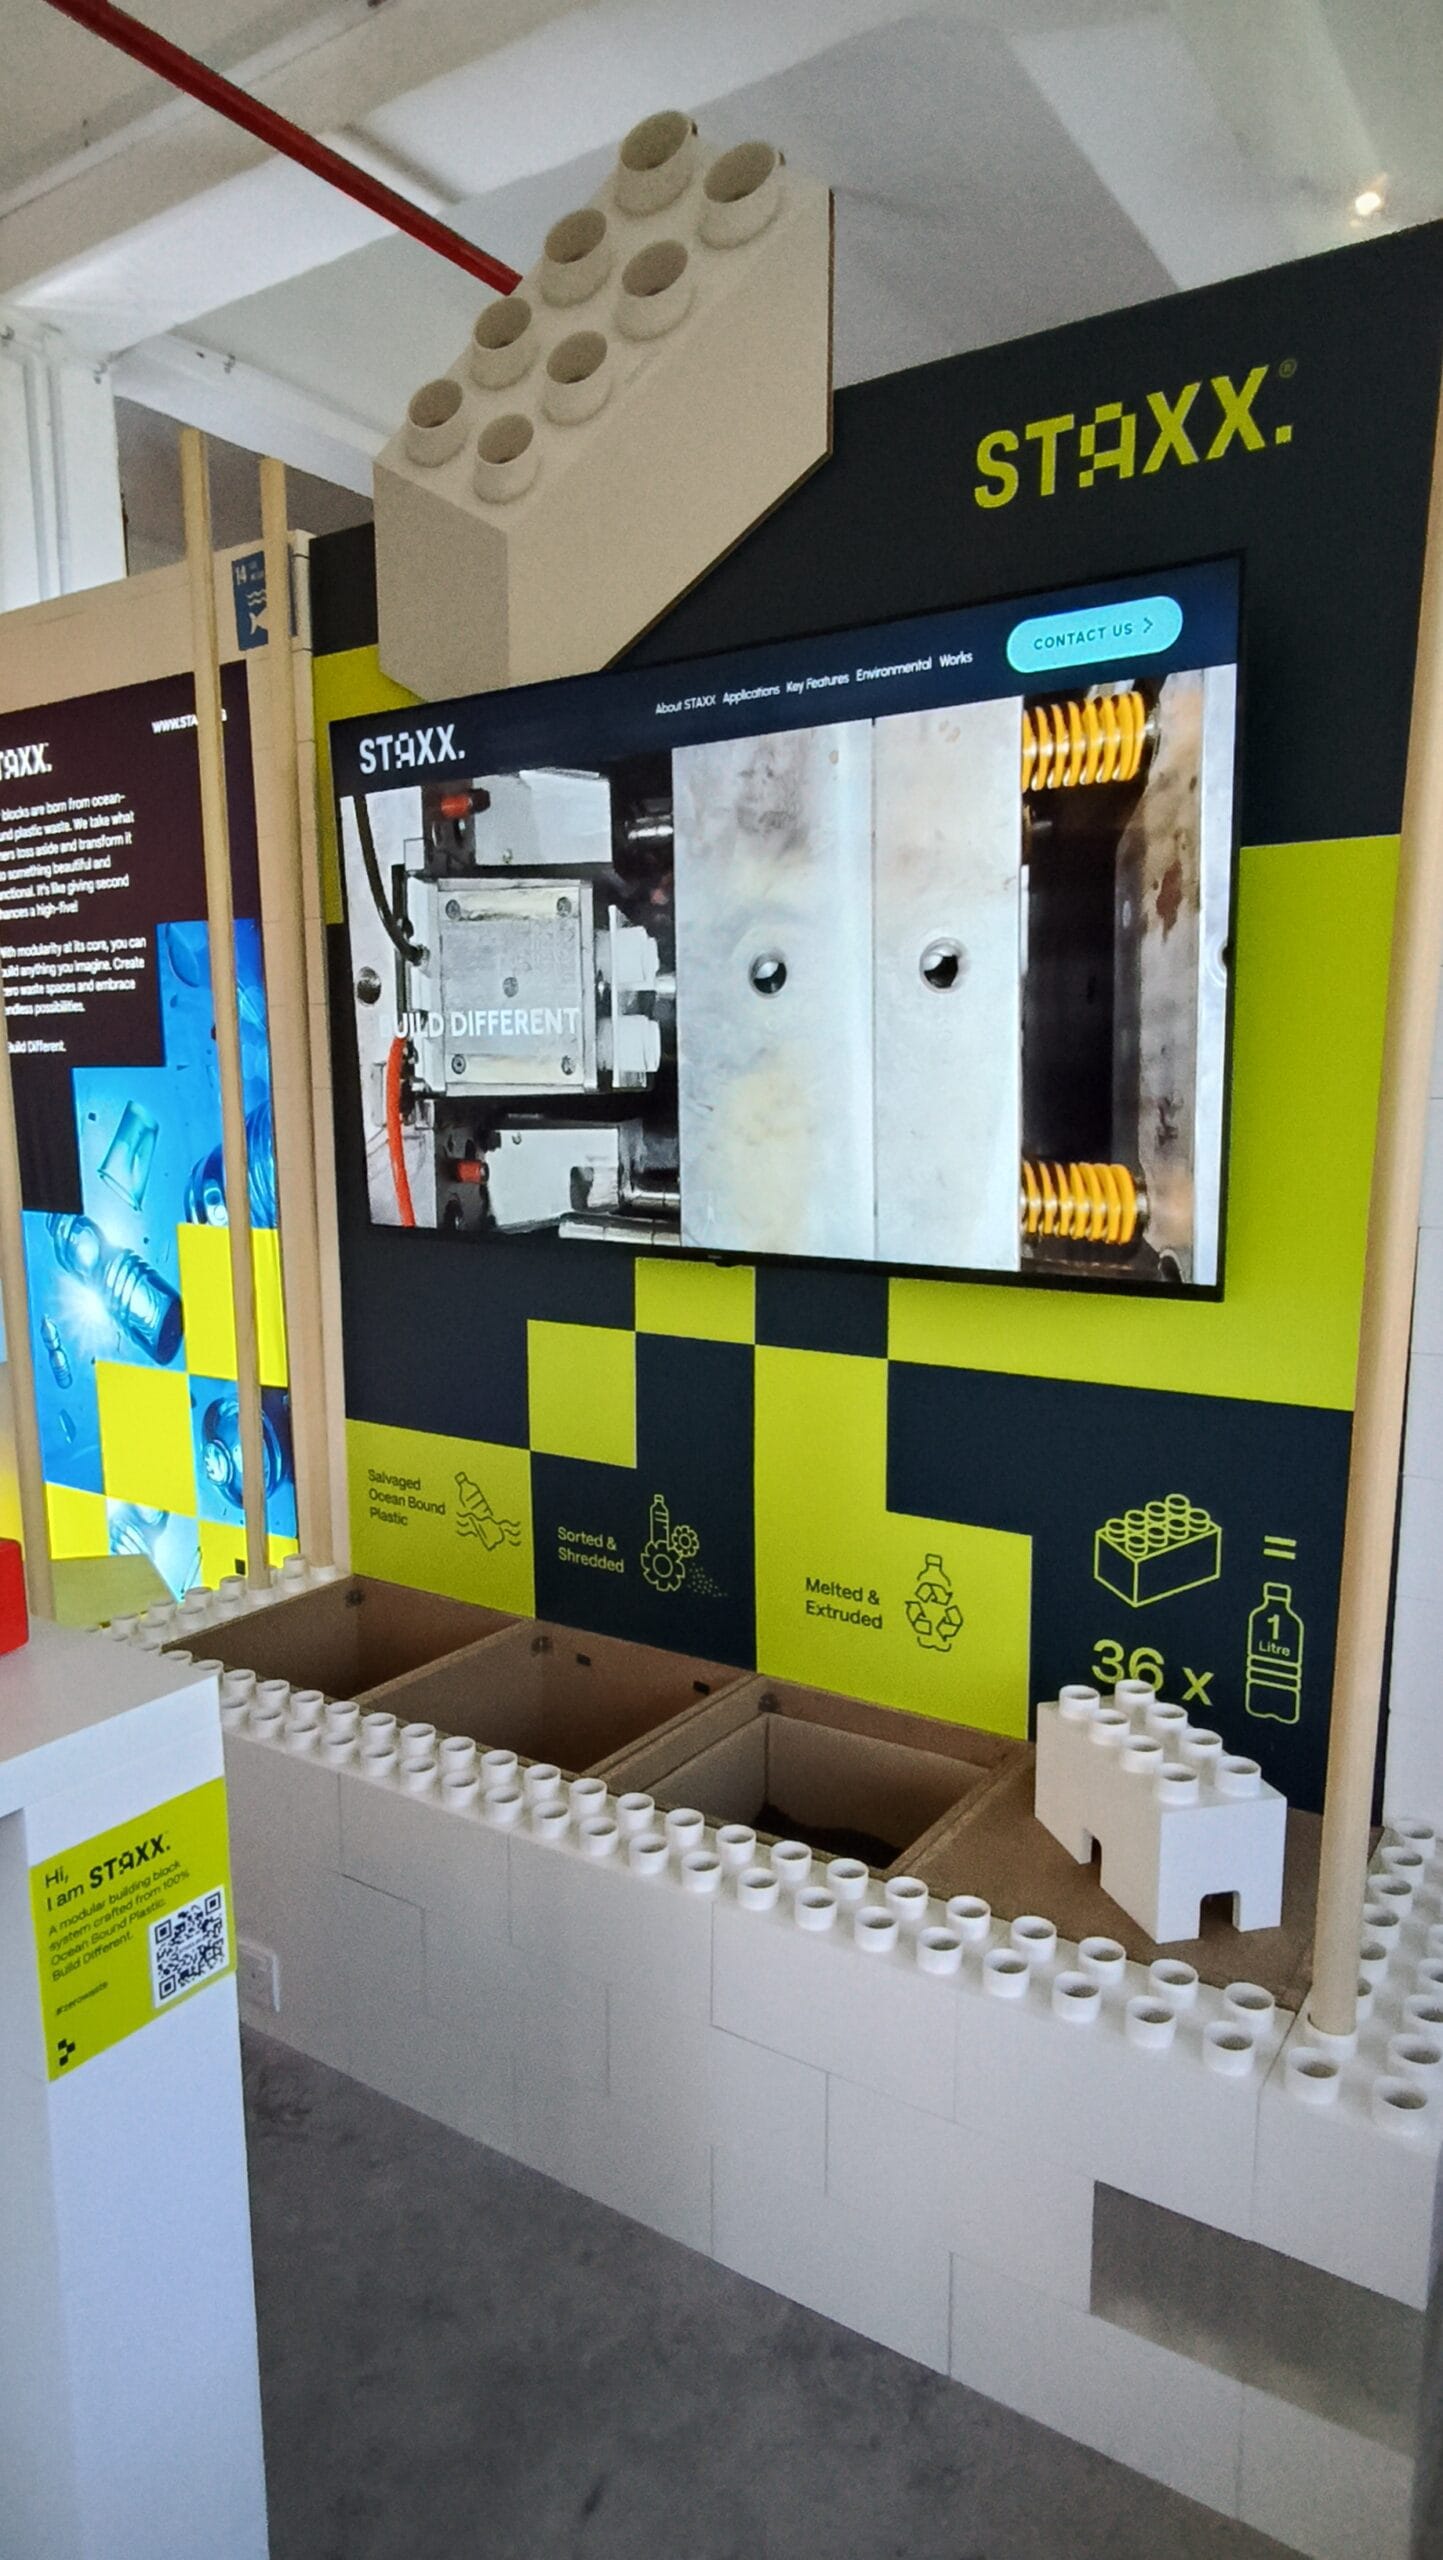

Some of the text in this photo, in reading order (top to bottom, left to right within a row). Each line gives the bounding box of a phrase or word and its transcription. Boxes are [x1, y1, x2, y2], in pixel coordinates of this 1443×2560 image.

[236, 564, 247, 586] 14
[1034, 623, 1133, 650] CONTACT US
[655, 651, 973, 714] About STAXX Applications Key Features Environmental Works
[359, 724, 466, 774] STAXX.
[1, 805, 30, 821] blocks
[30, 805, 45, 817] are
[68, 797, 90, 811] from
[14, 824, 43, 842] plastic
[72, 817, 88, 831] We
[89, 814, 110, 829] take
[111, 810, 135, 825] what
[35, 842, 59, 857] aside
[60, 838, 77, 852] and
[78, 833, 124, 850] transform
[124, 831, 133, 845] it
[7, 864, 52, 878] something
[52, 857, 92, 875] beautiful
[93, 854, 111, 869] and
[67, 878, 95, 896] giving
[95, 873, 130, 890] second
[17, 942, 62, 957] modularity
[63, 941, 72, 954] at
[110, 939, 128, 953] you
[129, 937, 147, 949] can
[20, 962, 56, 978] anything
[57, 963, 74, 977] you
[112, 956, 145, 970] Create
[20, 983, 45, 996] waste
[45, 982, 76, 997] spaces
[77, 978, 94, 992] and
[95, 977, 136, 992] embrace
[451, 1007, 580, 1037] DIFFERENT
[368, 1469, 421, 1491] Salvaged
[368, 1488, 446, 1515] Ocean Bound
[370, 1507, 408, 1526] Plastic
[557, 1526, 617, 1550] Sorted &
[558, 1547, 624, 1573] Shredded
[806, 1577, 880, 1605] Melted &
[806, 1600, 883, 1629] Extruded
[1267, 1614, 1280, 1640] 1
[1258, 1640, 1291, 1656] Litre
[1091, 1639, 1165, 1691] 36
[45, 1866, 69, 1889] Hi,
[47, 1834, 171, 1912] I am STAXX.
[49, 1860, 181, 1936] A modular building block
[49, 1924, 91, 1951] system
[93, 1901, 133, 1928] crafted
[135, 1885, 161, 1906] from
[51, 1940, 89, 1966] Ocean
[91, 1918, 127, 1944] Bound
[52, 1957, 81, 1982] Build
